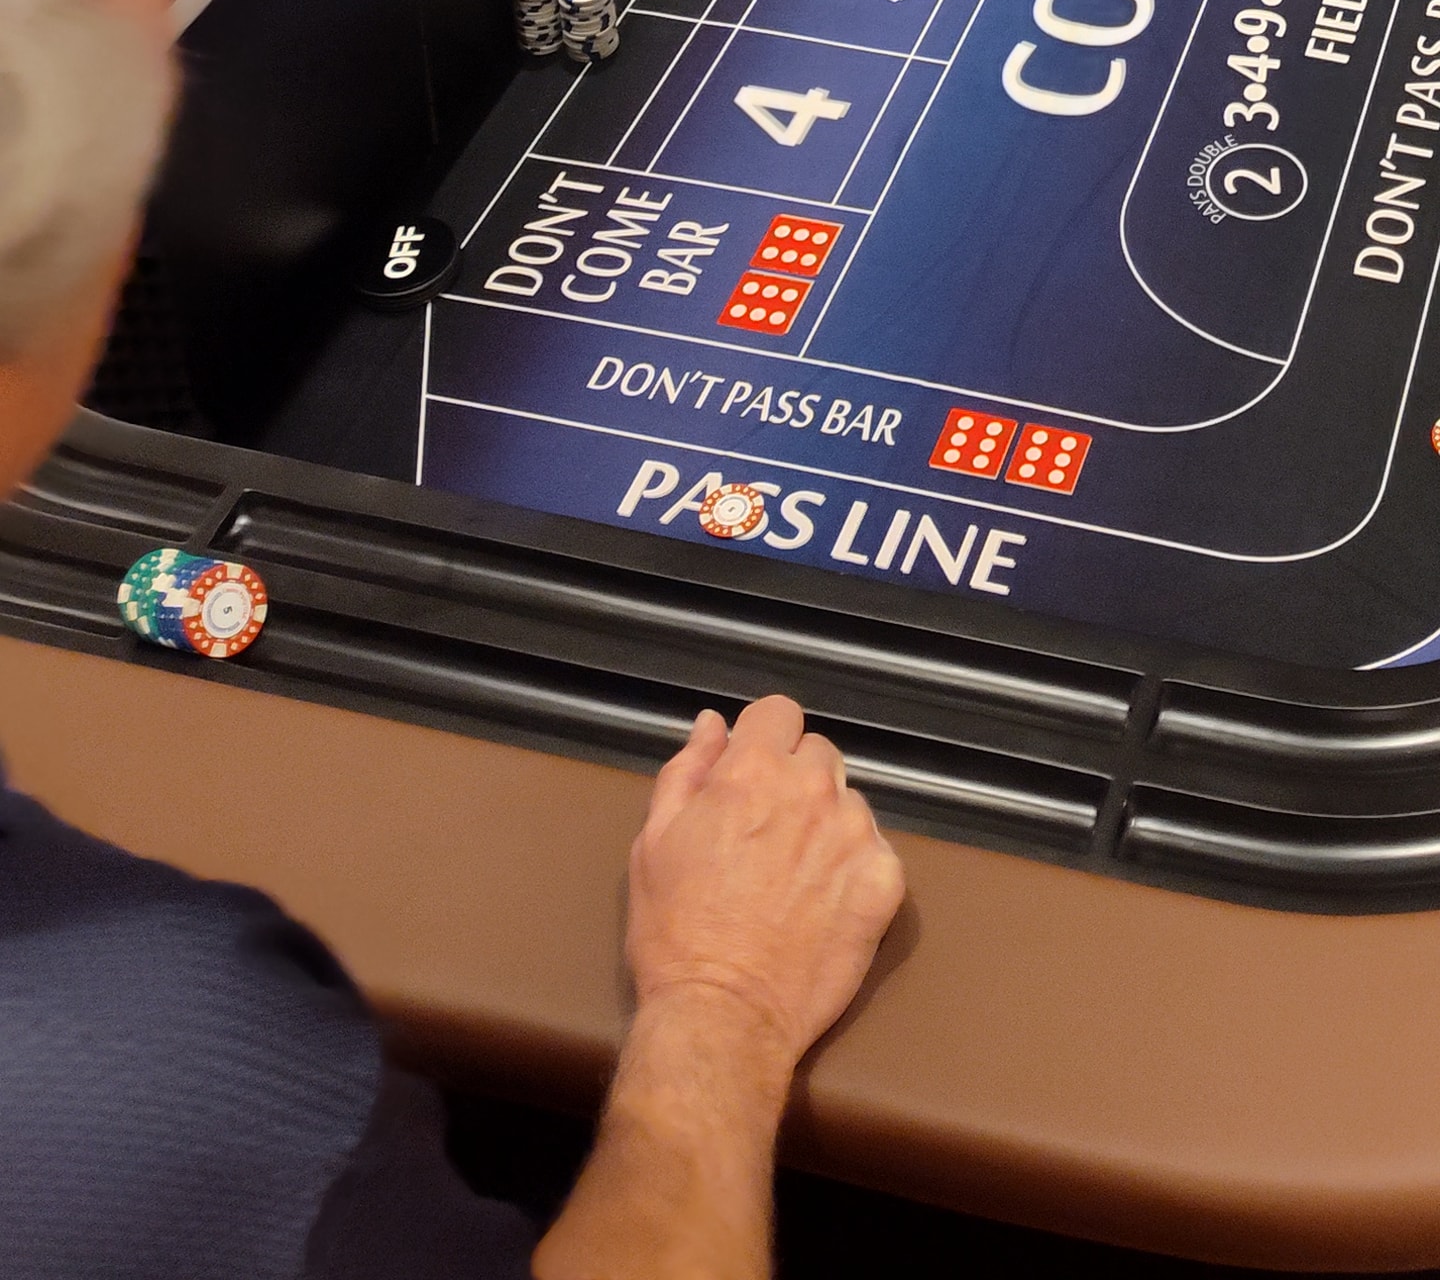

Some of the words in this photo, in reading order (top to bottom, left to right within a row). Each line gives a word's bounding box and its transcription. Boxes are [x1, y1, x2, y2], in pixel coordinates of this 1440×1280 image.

[732, 83, 852, 147] 4
[1187, 134, 1239, 187] DOUBLE
[1224, 167, 1281, 195] 2
[483, 170, 606, 298] DON'T
[562, 186, 674, 304] COME
[1189, 189, 1227, 225] PAYS
[1352, 131, 1434, 284] DON'T
[383, 224, 426, 281] OFF
[638, 218, 731, 297] BAR
[586, 354, 723, 412] DON'T
[720, 381, 823, 429] PASS
[820, 397, 905, 446] BAR
[829, 500, 1028, 596] LINE
